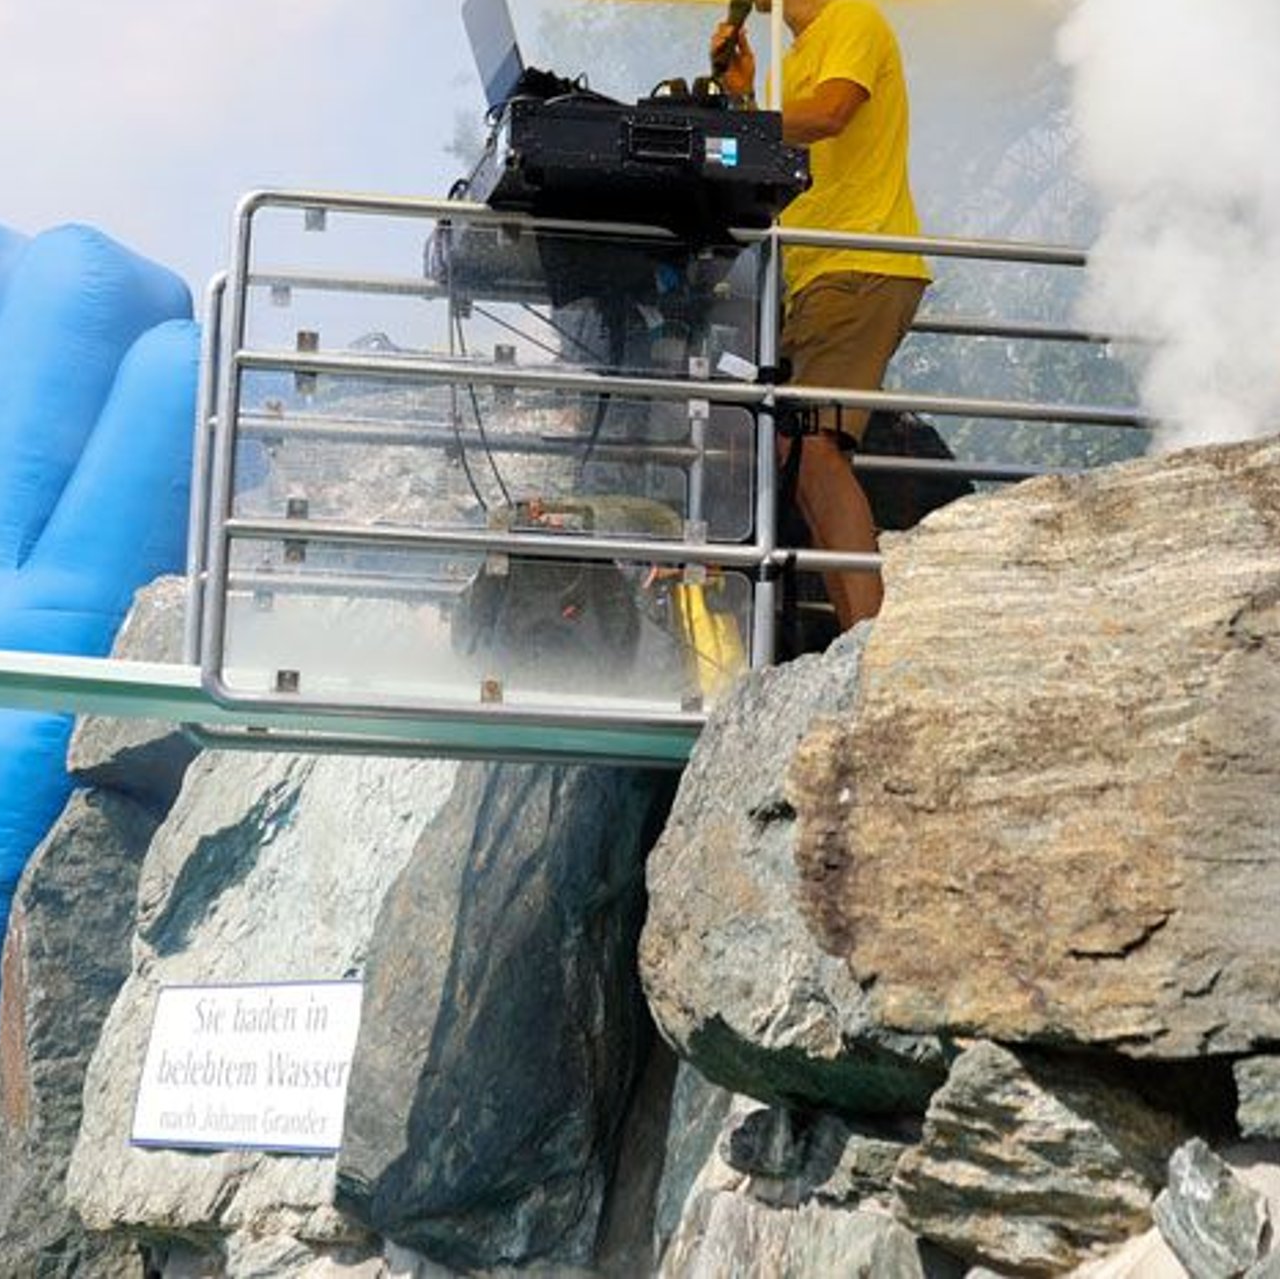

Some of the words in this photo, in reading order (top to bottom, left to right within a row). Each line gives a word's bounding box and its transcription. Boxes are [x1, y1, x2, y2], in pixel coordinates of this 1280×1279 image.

[193, 996, 226, 1035] Sie
[232, 994, 298, 1034] baden
[304, 991, 329, 1033] in
[156, 1048, 258, 1088] belebtem
[265, 1048, 350, 1088] Wasser
[159, 1102, 197, 1131] nach
[198, 1102, 258, 1135] Johann
